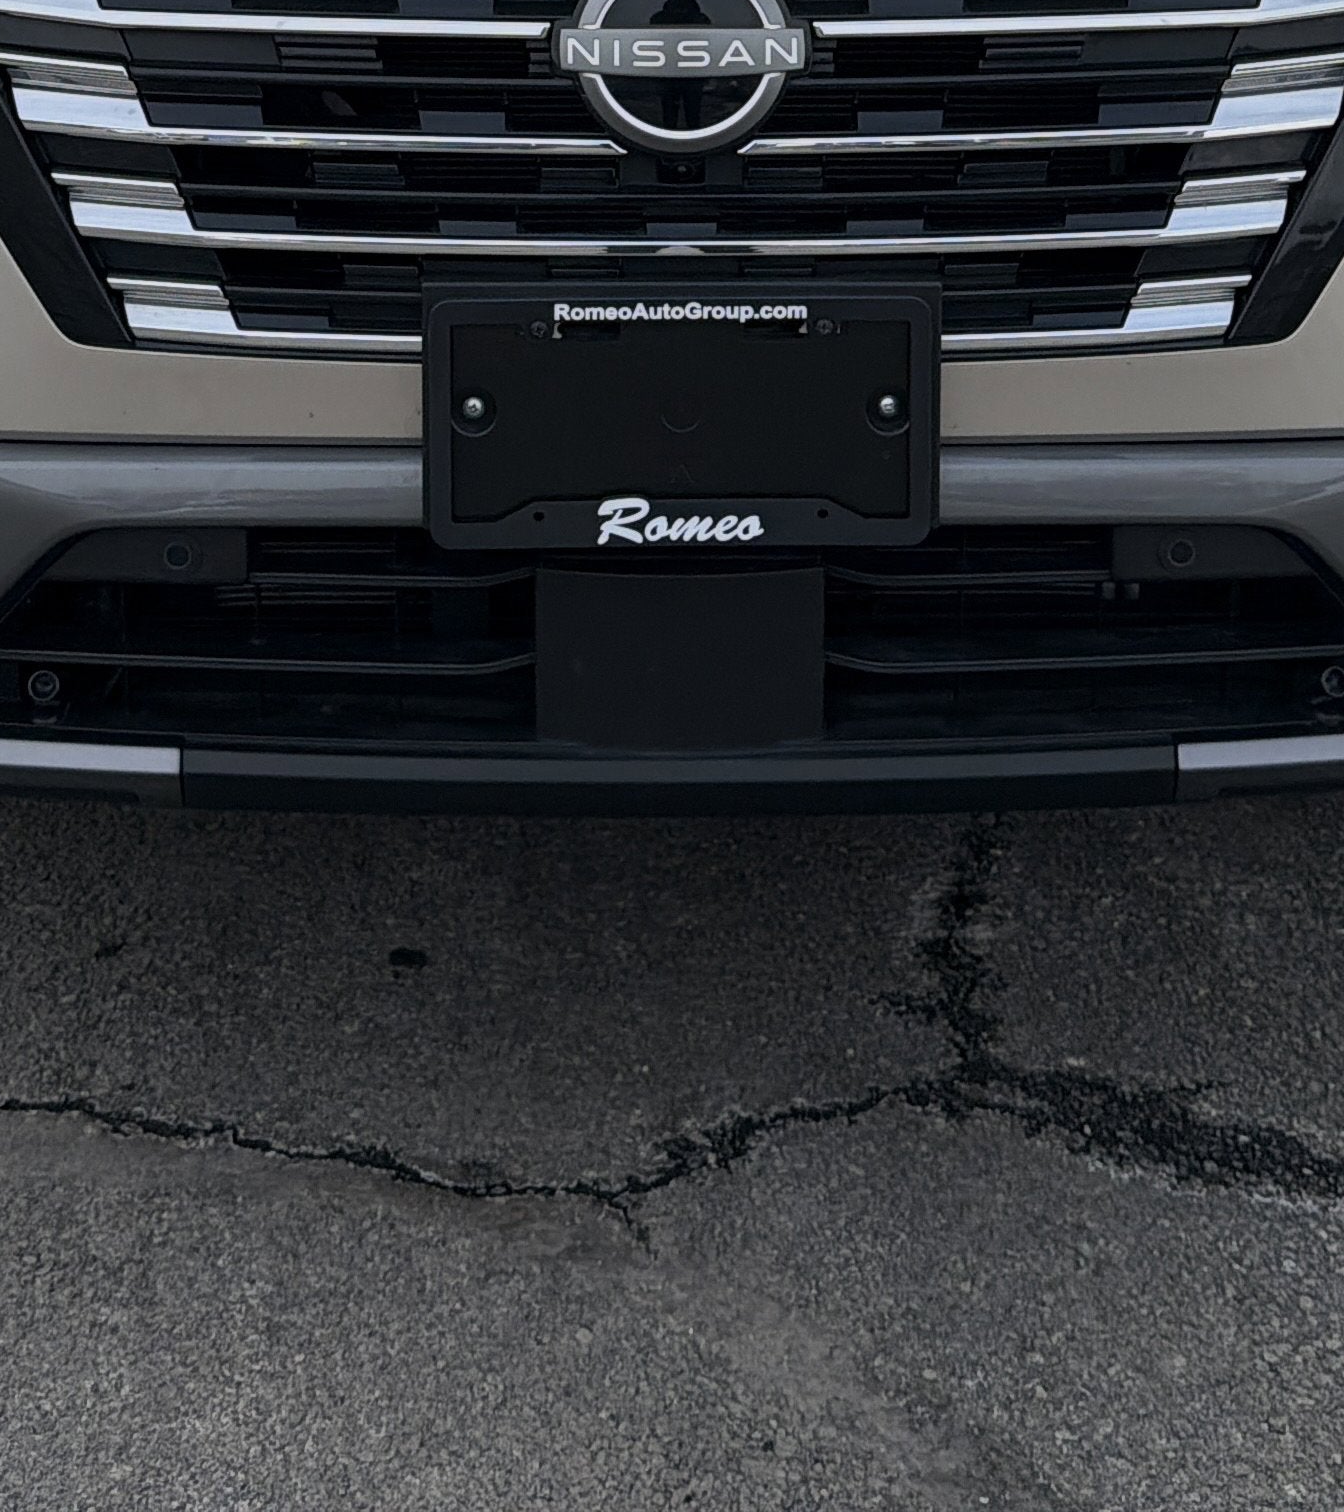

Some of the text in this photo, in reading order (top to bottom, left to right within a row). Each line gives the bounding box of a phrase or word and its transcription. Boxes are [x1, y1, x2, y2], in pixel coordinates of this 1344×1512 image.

[567, 37, 798, 67] NISSAN
[553, 302, 808, 323] RomeoAutoGroup.com
[597, 497, 765, 546] Romeo
